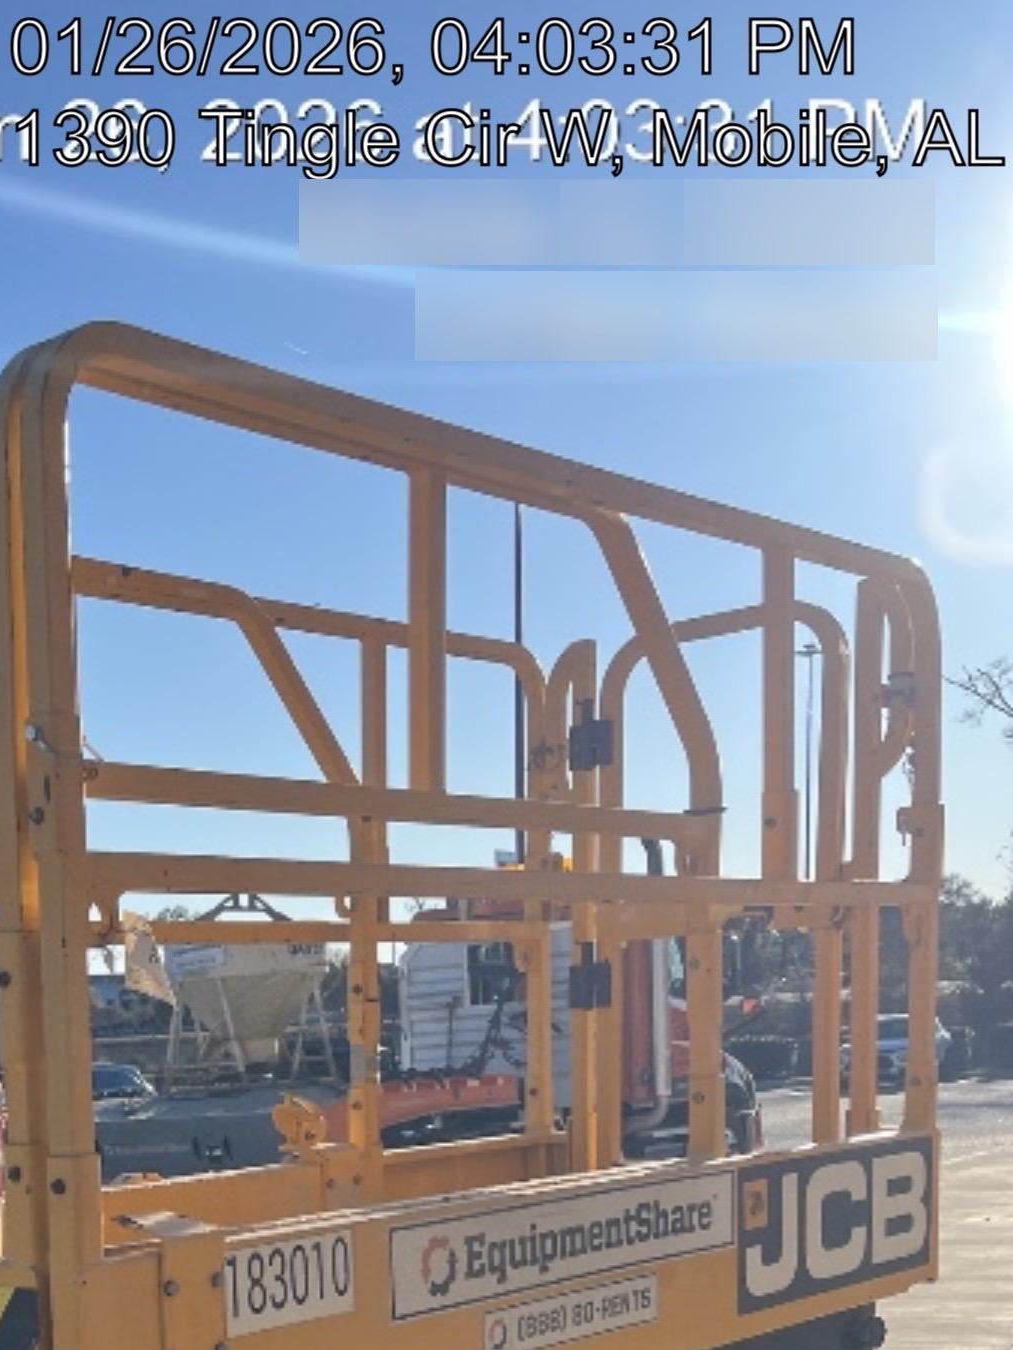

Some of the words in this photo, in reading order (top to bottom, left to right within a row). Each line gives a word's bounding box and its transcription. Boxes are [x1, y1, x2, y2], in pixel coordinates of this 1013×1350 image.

[463, 1199, 713, 1285] EquipmentShare
[745, 1151, 928, 1298] JCB
[225, 1235, 351, 1319] 183010
